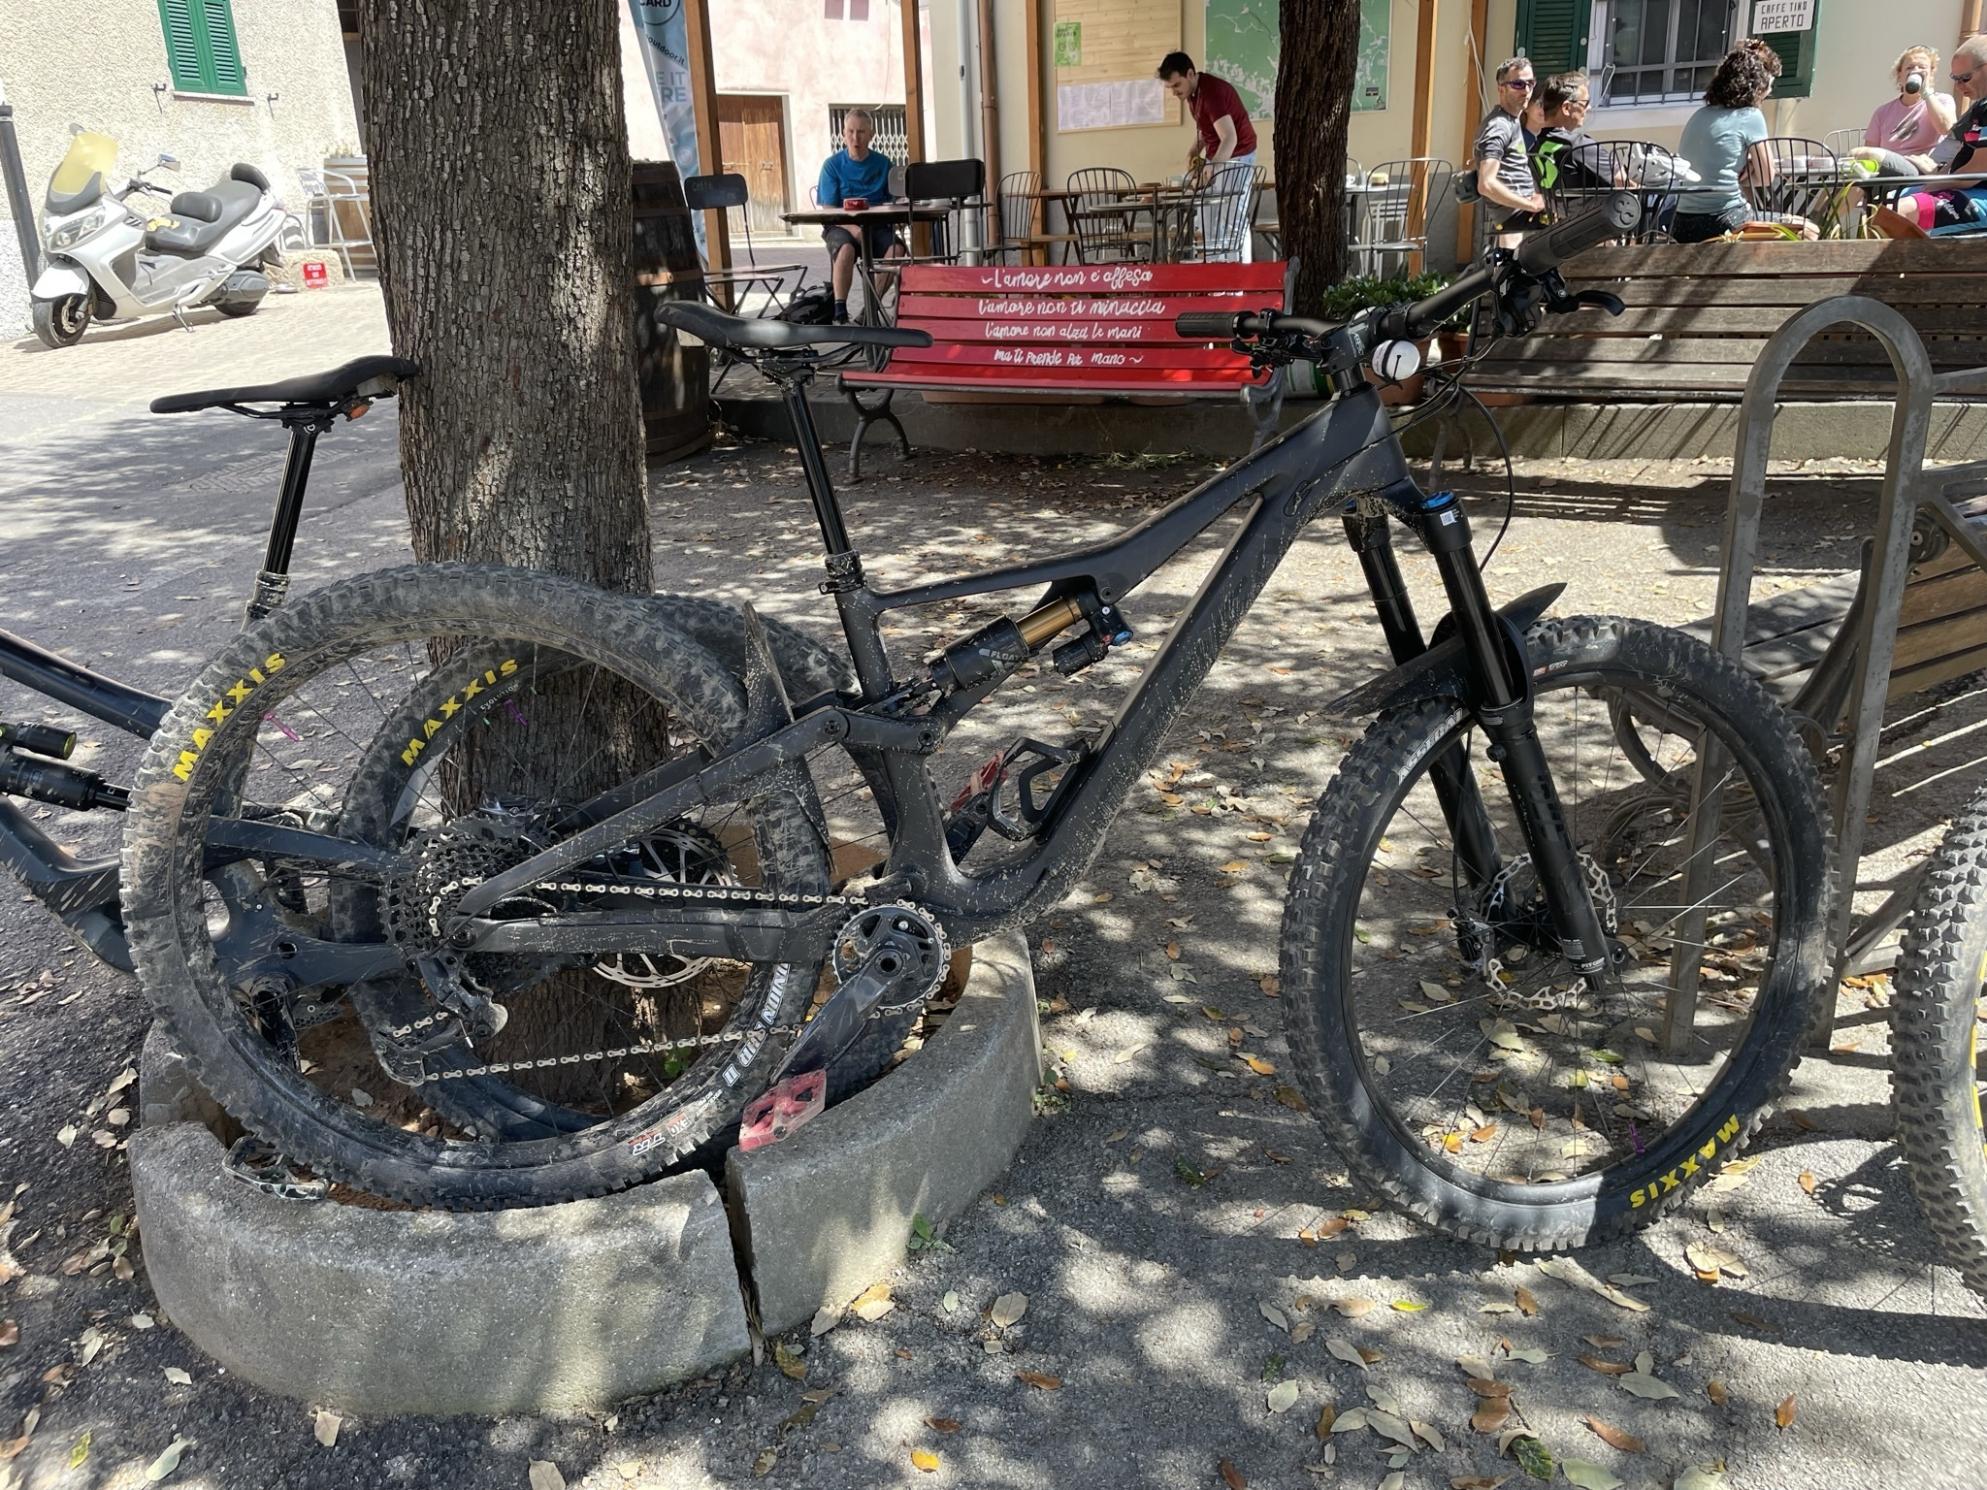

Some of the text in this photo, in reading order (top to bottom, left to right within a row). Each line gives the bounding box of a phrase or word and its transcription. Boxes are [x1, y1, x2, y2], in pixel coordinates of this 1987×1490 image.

[1761, 14, 1804, 30] APERTO
[670, 71, 685, 86] IT
[994, 269, 1053, 290] L'amore
[1054, 270, 1086, 286] non
[1037, 302, 1067, 315] non
[1070, 300, 1086, 316] ti
[1089, 300, 1166, 317] minaccia
[1033, 324, 1056, 337] non
[1059, 323, 1089, 340] alza
[1091, 322, 1104, 339] le
[1107, 325, 1143, 340] mani
[994, 349, 1012, 363] ma
[1013, 347, 1025, 363] ti
[1091, 351, 1126, 366] mano
[172, 653, 286, 781] MAXXIS
[401, 659, 518, 767] MAXXIS
[1629, 1113, 1740, 1208] MAXXIS
